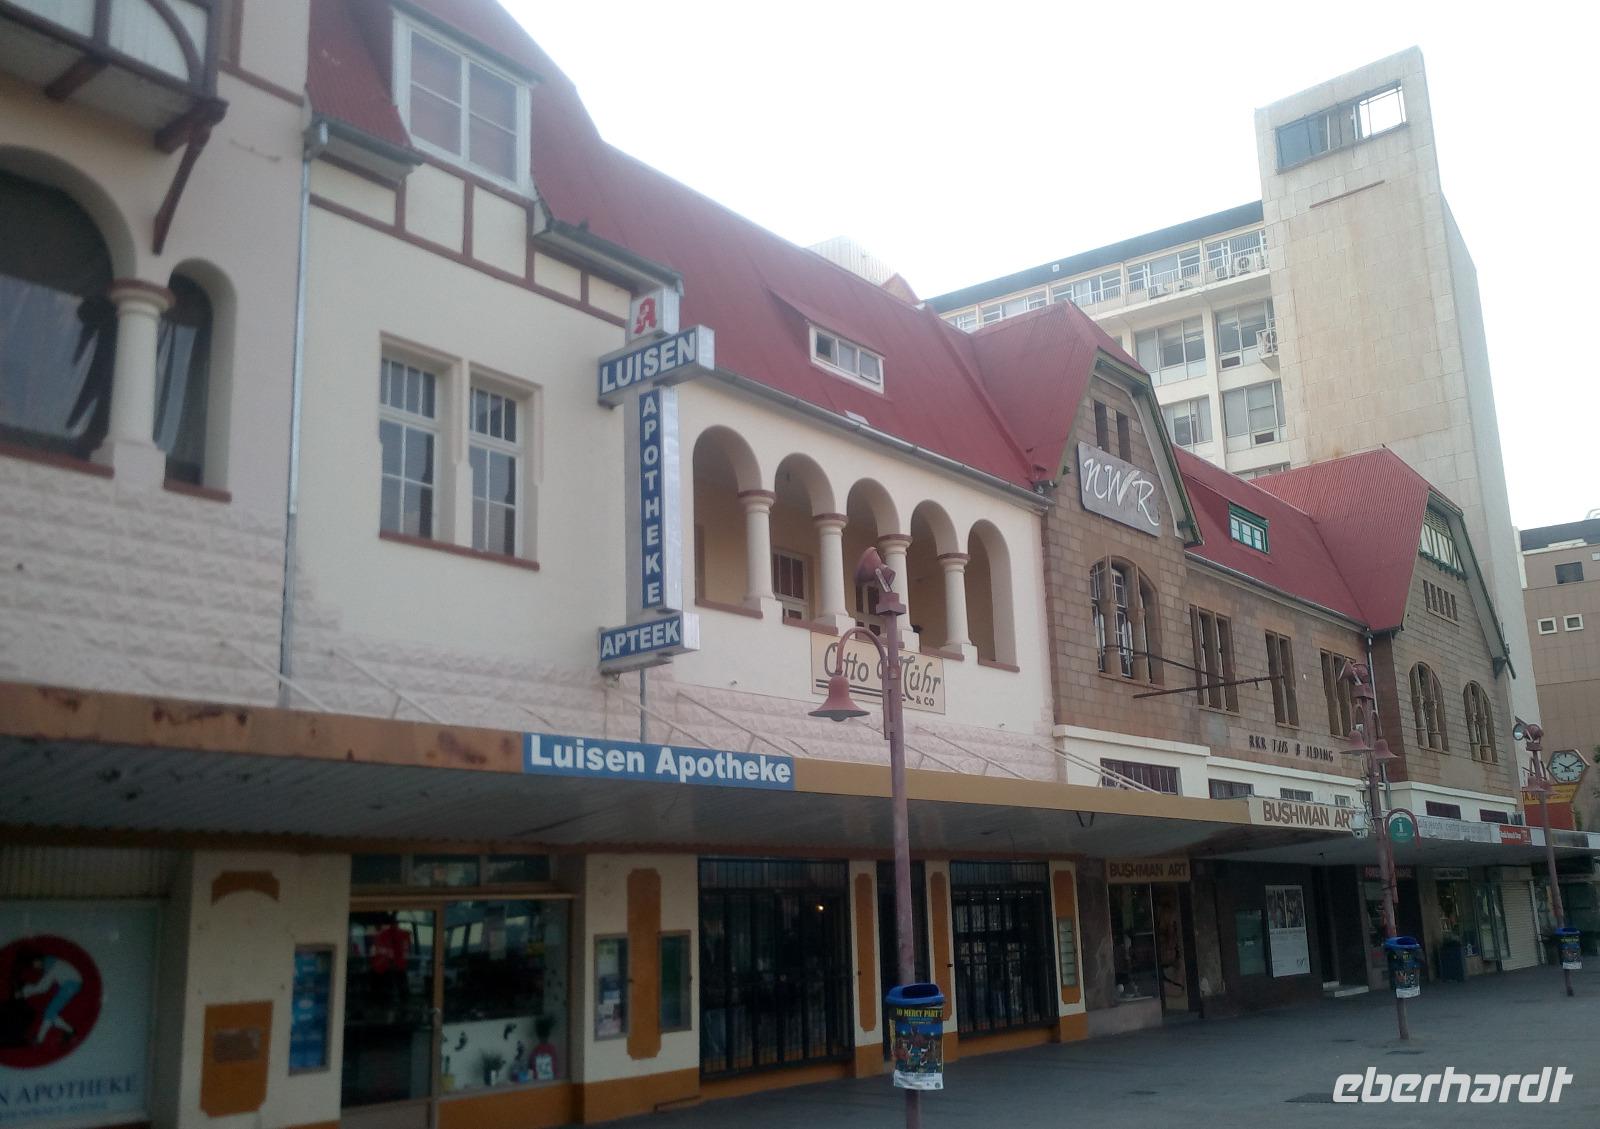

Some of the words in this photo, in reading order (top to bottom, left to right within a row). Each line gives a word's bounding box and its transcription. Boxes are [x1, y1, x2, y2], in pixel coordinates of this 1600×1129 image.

[601, 331, 697, 394] LUISEN
[642, 394, 661, 606] APOTHEKE
[1084, 458, 1159, 526] NWR
[601, 618, 680, 660] APTEEK
[824, 642, 870, 683] Otto
[530, 734, 645, 773] Luisen
[655, 747, 792, 784] Apotheke
[1262, 799, 1330, 826] BUSHMAN
[1110, 862, 1164, 878] BUSHMAN
[1168, 862, 1187, 877] ART
[16, 1072, 138, 1104] APOTHEKE
